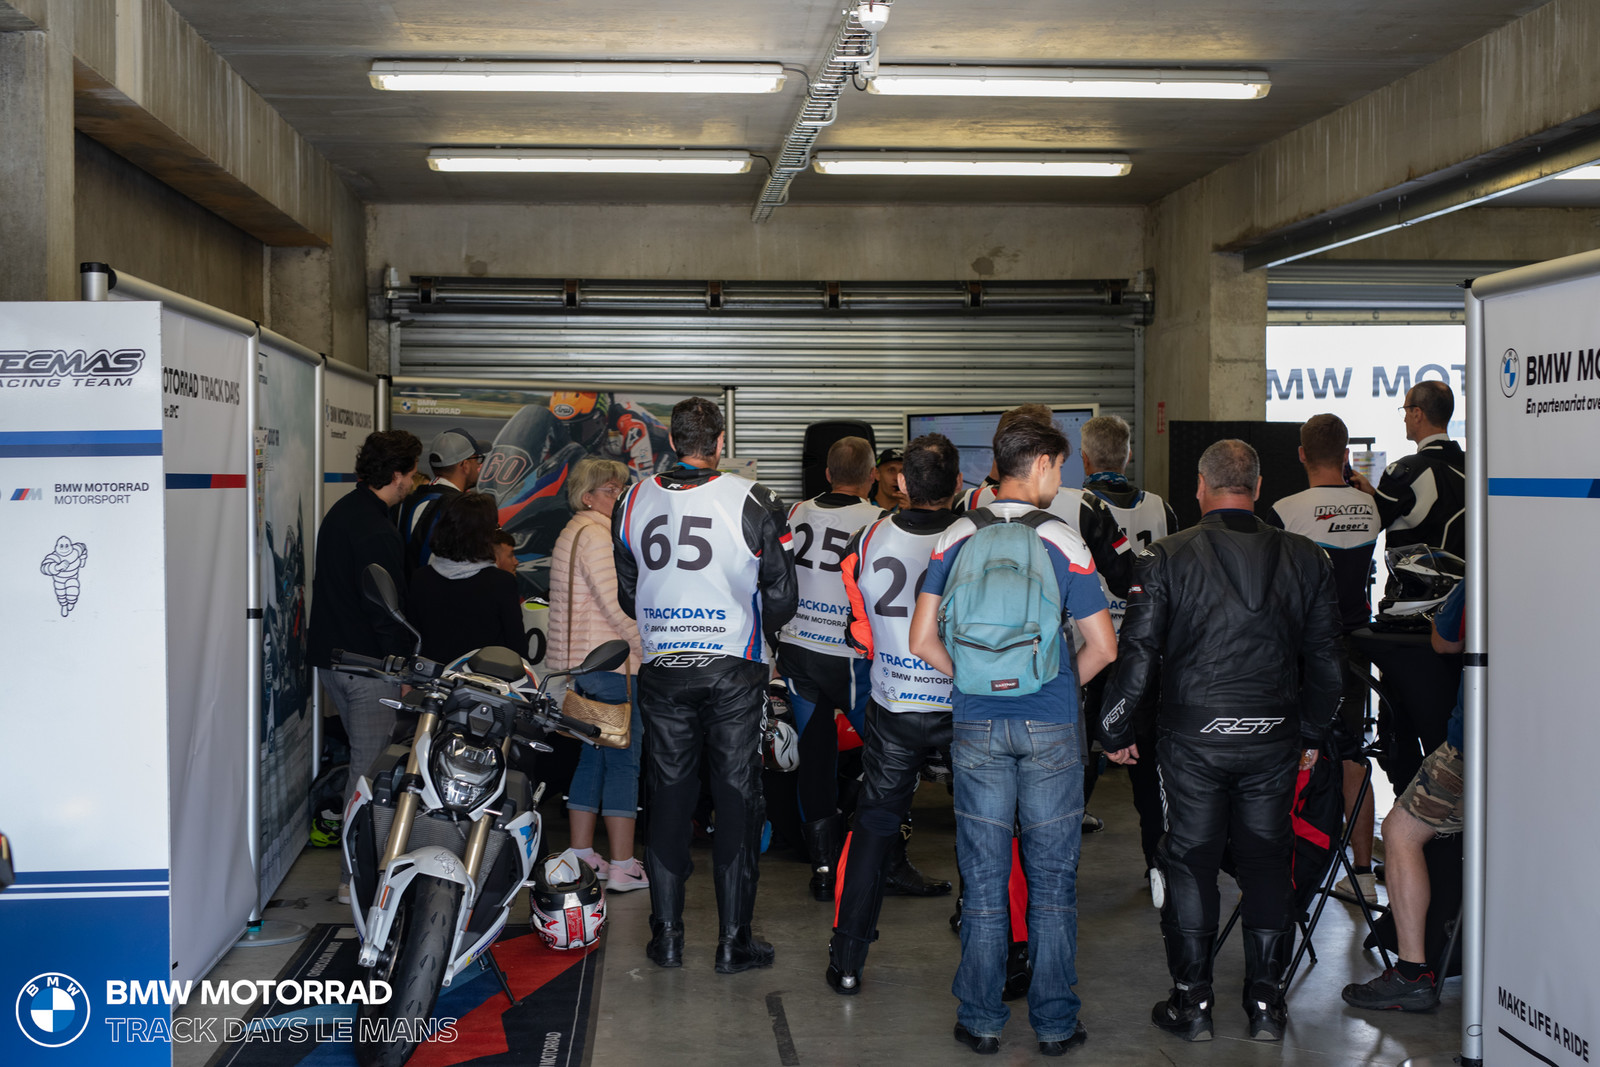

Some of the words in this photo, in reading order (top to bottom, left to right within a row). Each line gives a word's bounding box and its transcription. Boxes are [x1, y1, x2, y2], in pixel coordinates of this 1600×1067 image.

[0, 349, 145, 377] ECMAS
[1526, 351, 1573, 386] BMW
[0, 379, 61, 388] CING
[73, 378, 133, 387] TEAM
[163, 367, 199, 398] OTORRAD
[200, 375, 224, 403] TRACK
[224, 380, 240, 406] DAYS
[1267, 368, 1353, 400] MW
[1372, 363, 1466, 398] MOT
[417, 407, 461, 415] MOTORRAD
[1526, 398, 1536, 414] En
[1537, 394, 1586, 418] partenariat
[480, 453, 527, 485] 60
[54, 483, 82, 492] BMW
[85, 482, 149, 492] MOTORRAD
[55, 495, 131, 504] MOTORSPORT
[1314, 504, 1373, 517] DRAGON
[1328, 522, 1369, 533] Laeger's
[641, 514, 713, 571] 65
[795, 522, 850, 572] 25
[643, 608, 726, 620] TRACKDAYS
[798, 598, 851, 616] ACKDAYS
[670, 625, 726, 633] MOTORRAD
[811, 616, 847, 628] MOTORRA
[657, 641, 724, 650] MICHELIN
[654, 653, 727, 668] RST
[891, 671, 911, 682] BMW
[899, 692, 953, 704] MICHEL
[1102, 698, 1126, 731] RST
[1200, 717, 1286, 735] RST
[1498, 986, 1526, 1023] MAKE
[1528, 1005, 1552, 1038] LIFE
[1554, 1021, 1562, 1045] A
[1563, 1026, 1590, 1064] RIDE
[539, 1031, 562, 1066] MOTORRAD
